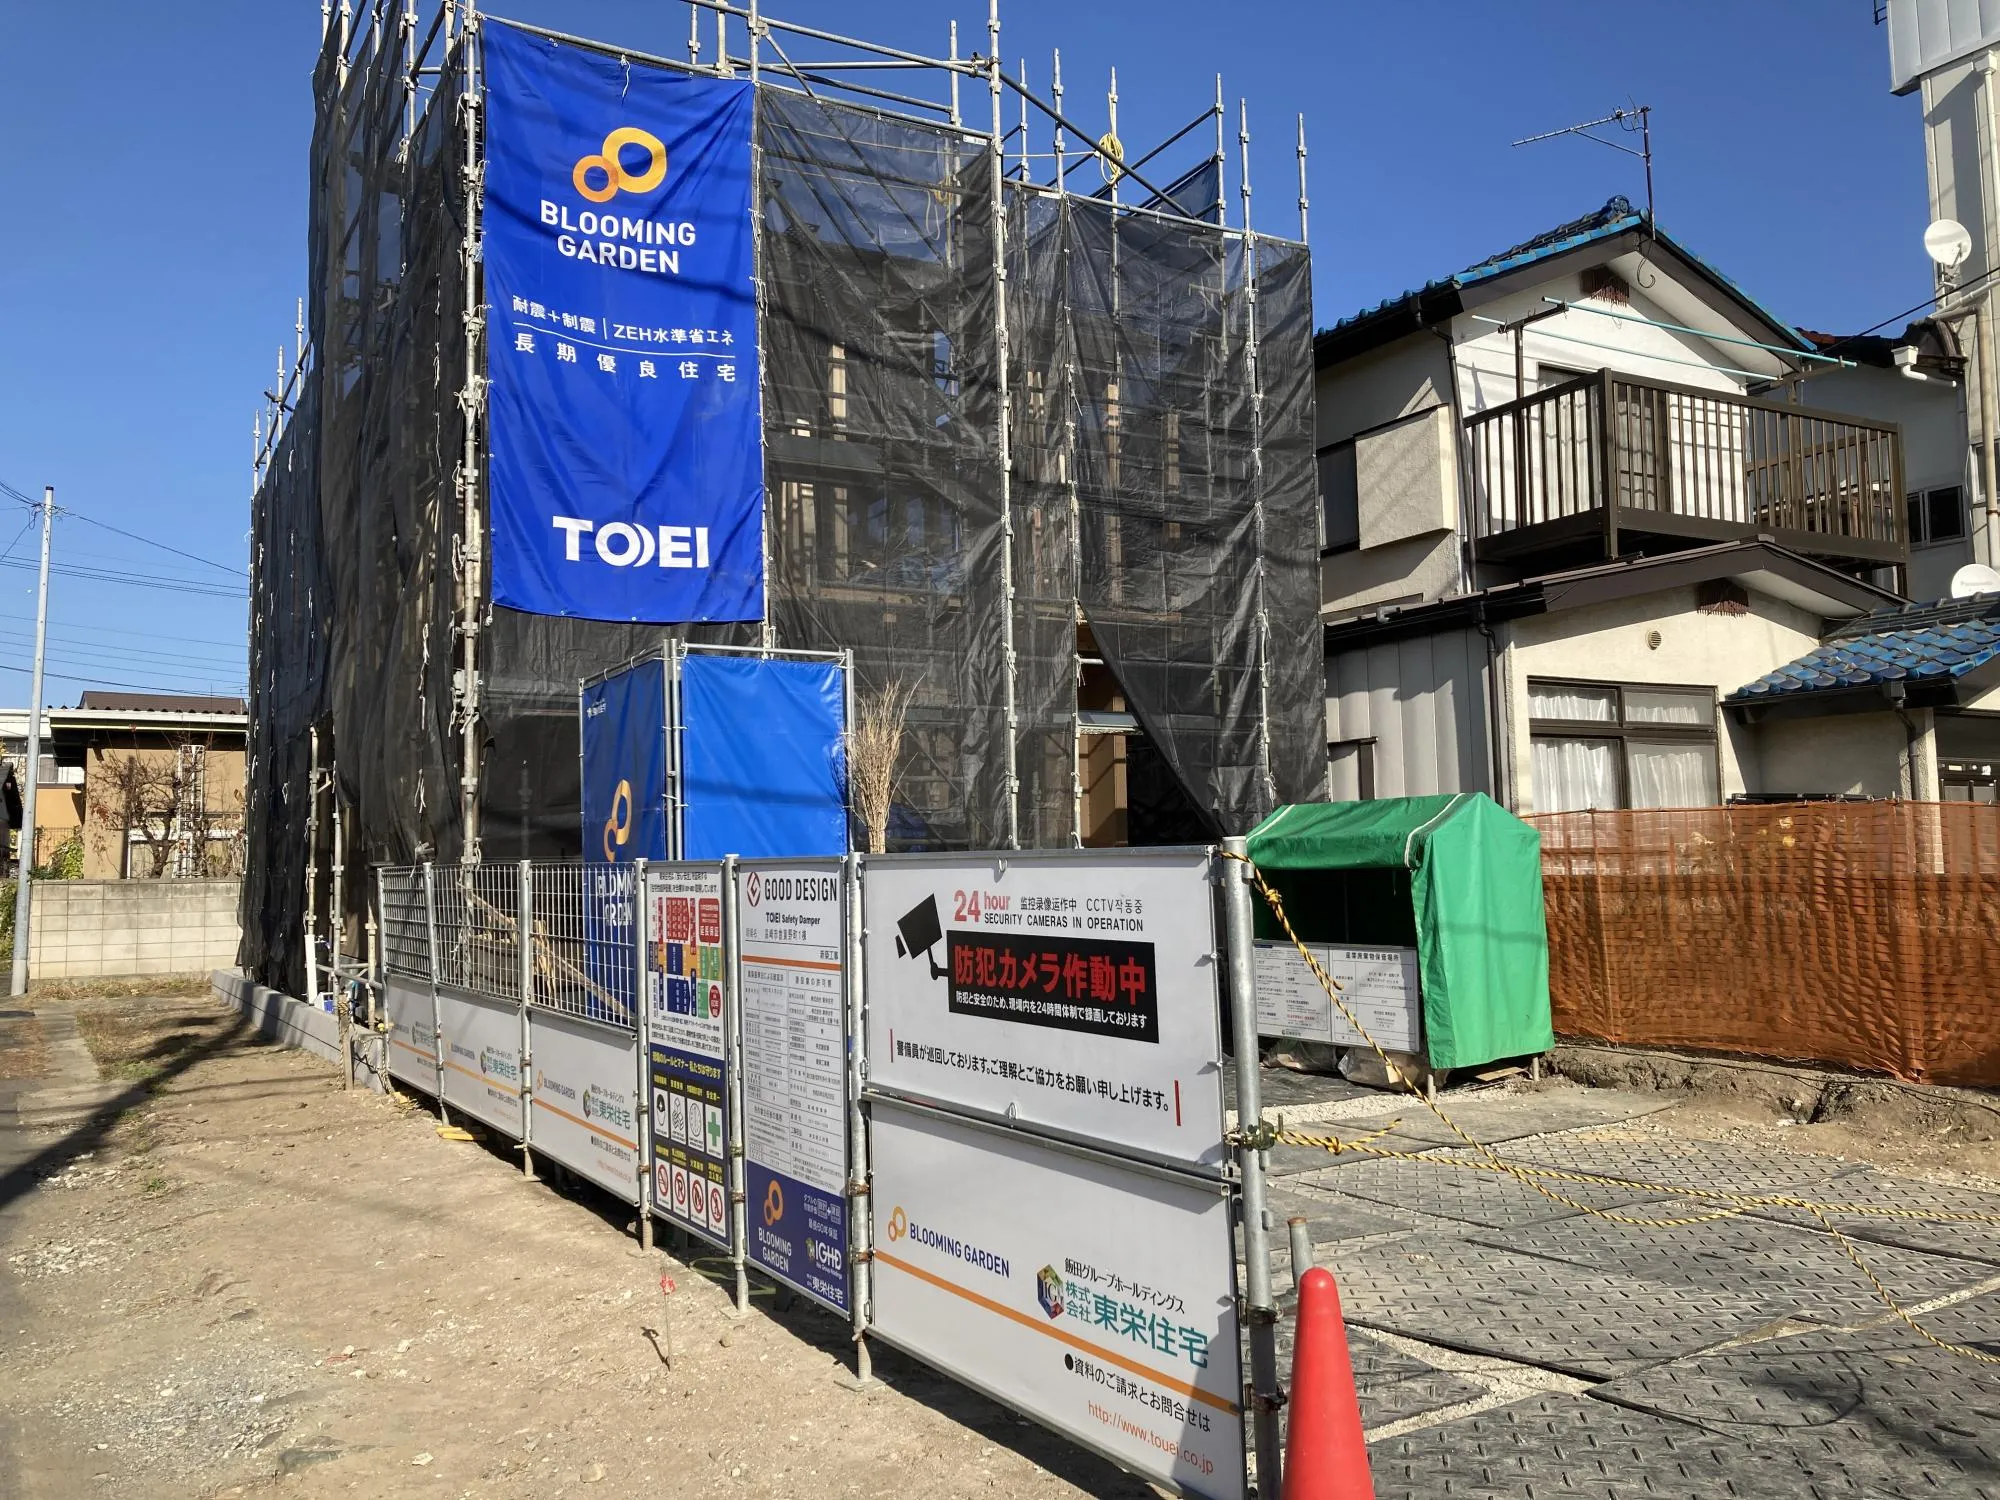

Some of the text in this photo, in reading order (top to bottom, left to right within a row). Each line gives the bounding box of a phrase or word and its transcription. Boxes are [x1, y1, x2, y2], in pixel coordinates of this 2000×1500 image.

[540, 200, 696, 246] BLOOMING
[557, 236, 679, 274] GARDEN
[513, 295, 734, 346] 耐震+制震 ZEH水準省エネ
[515, 333, 736, 382] 長期優良住宅
[553, 516, 709, 569] TOEI
[764, 878, 837, 902] GOOD DESIGN
[954, 890, 1011, 922] 24 hour
[1020, 896, 1077, 912] 监控录像运作中
[782, 914, 798, 926] Safety
[799, 914, 820, 926] Damper
[984, 913, 1144, 932] SECURITY CAMERAS IN OPERATION
[954, 944, 1146, 1006] 防犯カメラ作動中
[896, 1039, 1169, 1112] 警備員が巡回しております。ご理解とご協力をお願い申し上げます。
[599, 1100, 631, 1130] 東栄住宅
[758, 1227, 792, 1256] BLOOMING
[762, 1248, 789, 1273] GARDEN
[910, 1222, 1010, 1278] BLOOMING GARDEN
[1064, 1257, 1185, 1314] 飯田グループホールディングス
[1092, 1293, 1209, 1369] 東栄住宅
[1088, 1400, 1214, 1475] http://www.touei.co.jp
